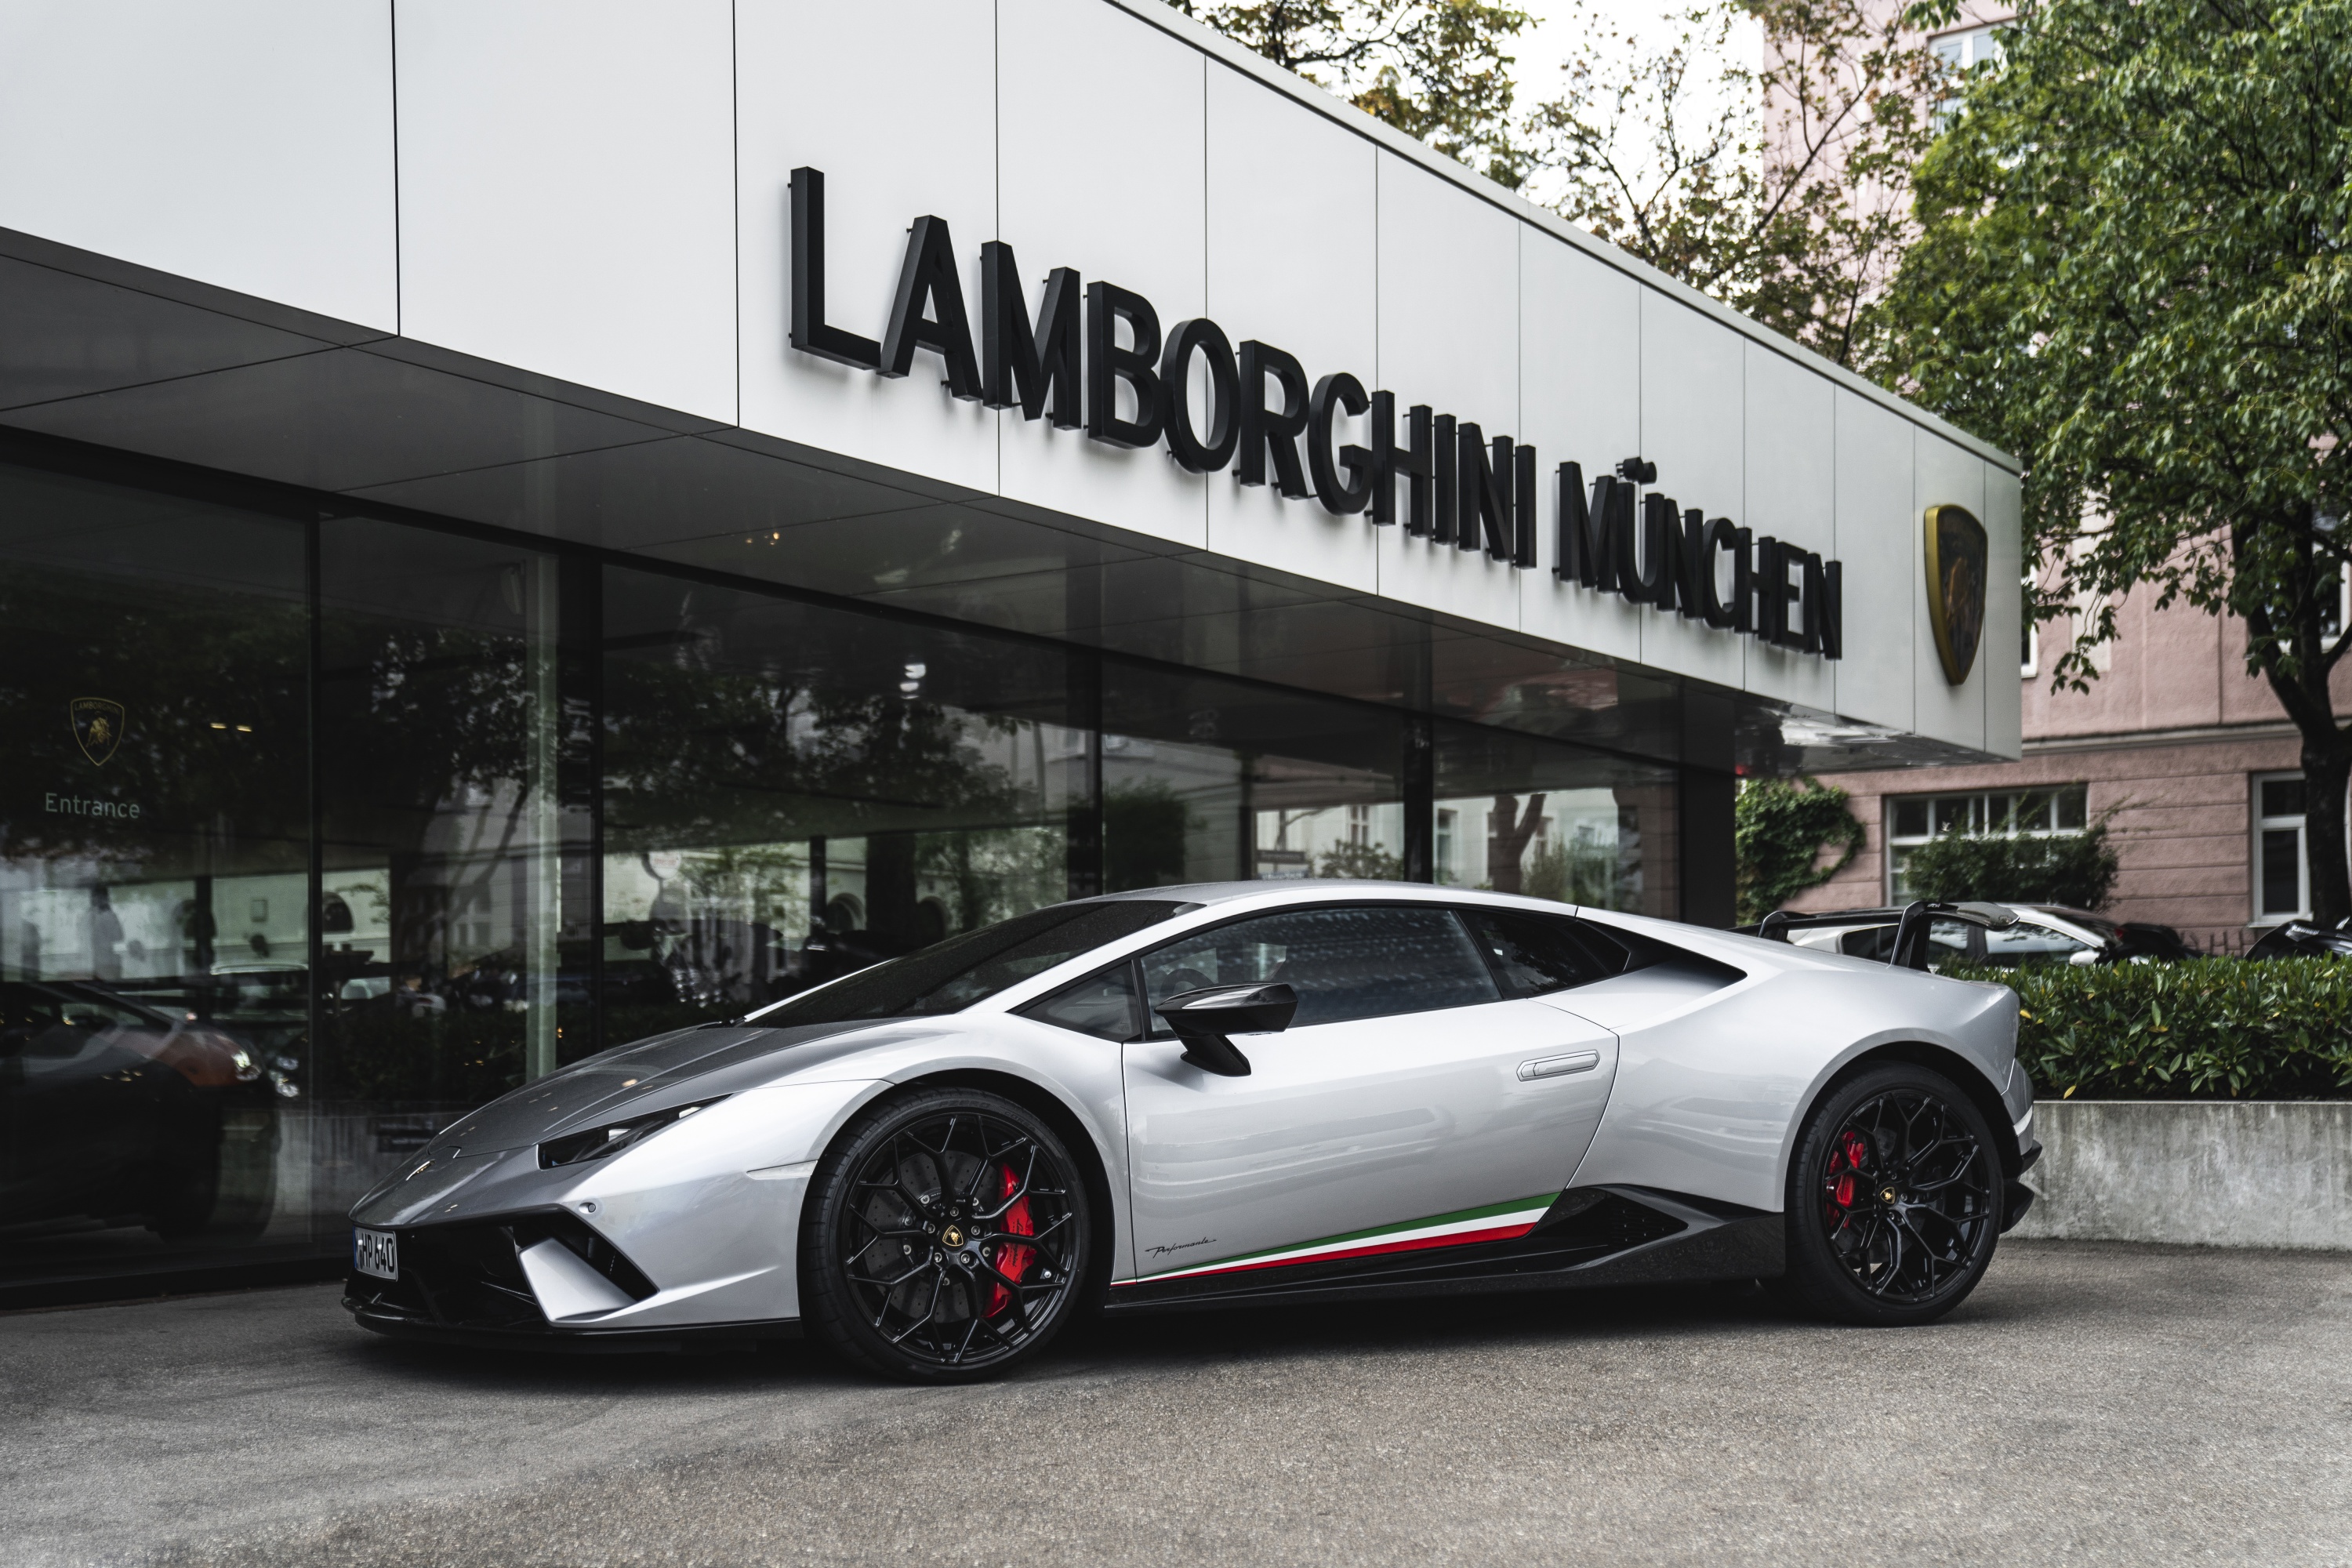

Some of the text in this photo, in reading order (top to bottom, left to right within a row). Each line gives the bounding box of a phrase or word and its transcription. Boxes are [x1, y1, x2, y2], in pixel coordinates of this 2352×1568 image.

[789, 165, 1842, 660] LAMBORGHINI MÜNCHEN
[45, 792, 141, 819] Entrance
[375, 1235, 395, 1273] 640
